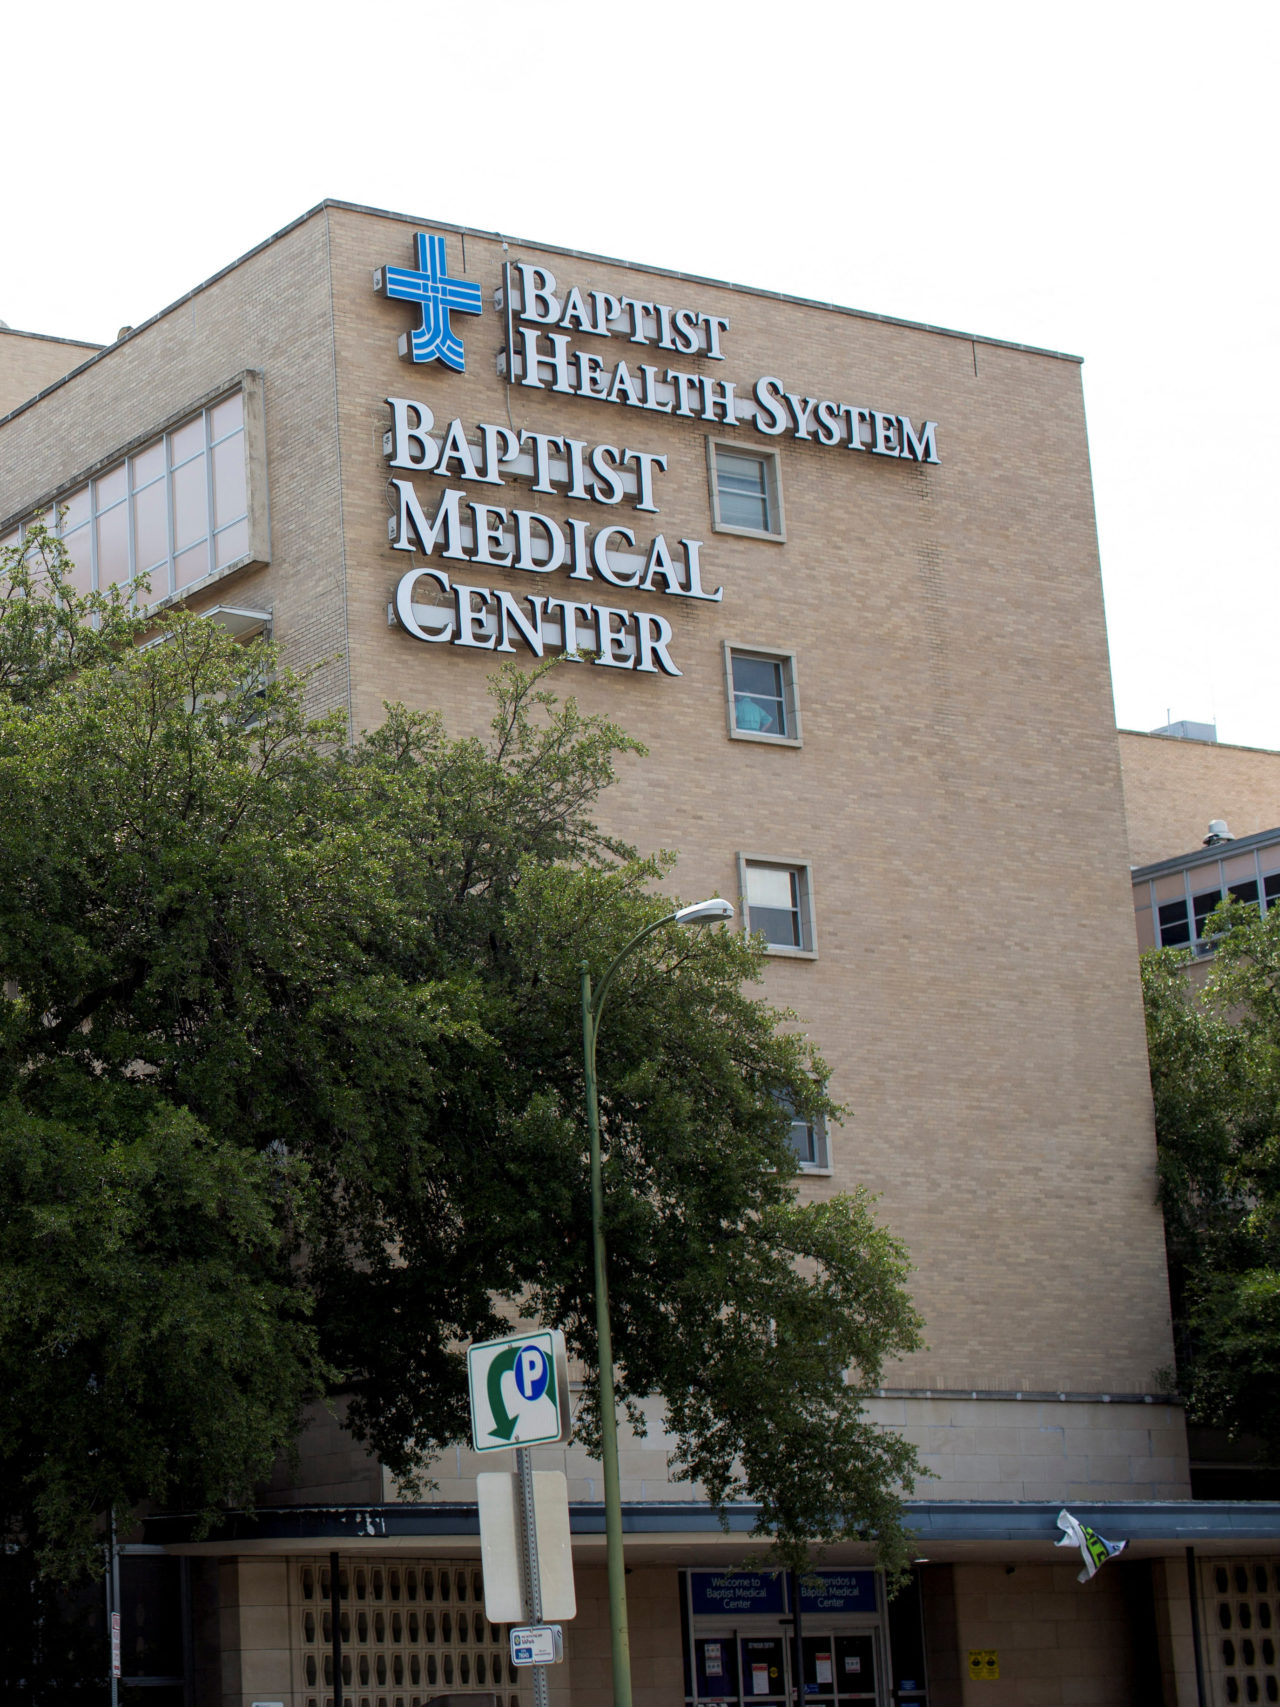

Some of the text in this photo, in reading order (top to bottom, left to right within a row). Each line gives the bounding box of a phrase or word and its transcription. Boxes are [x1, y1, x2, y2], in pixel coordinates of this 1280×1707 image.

[516, 263, 730, 361] BAPTIST
[519, 327, 941, 465] HEALTH SYSTEM
[386, 397, 668, 512] BAPTIST
[392, 479, 724, 602] MEDICAL
[396, 567, 683, 677] CENTER
[706, 1587, 767, 1600] Baptist Medical
[711, 1577, 761, 1588] Welcome to
[723, 1599, 751, 1610] Center
[817, 1597, 845, 1608] Center
[830, 1585, 860, 1597] Medical
